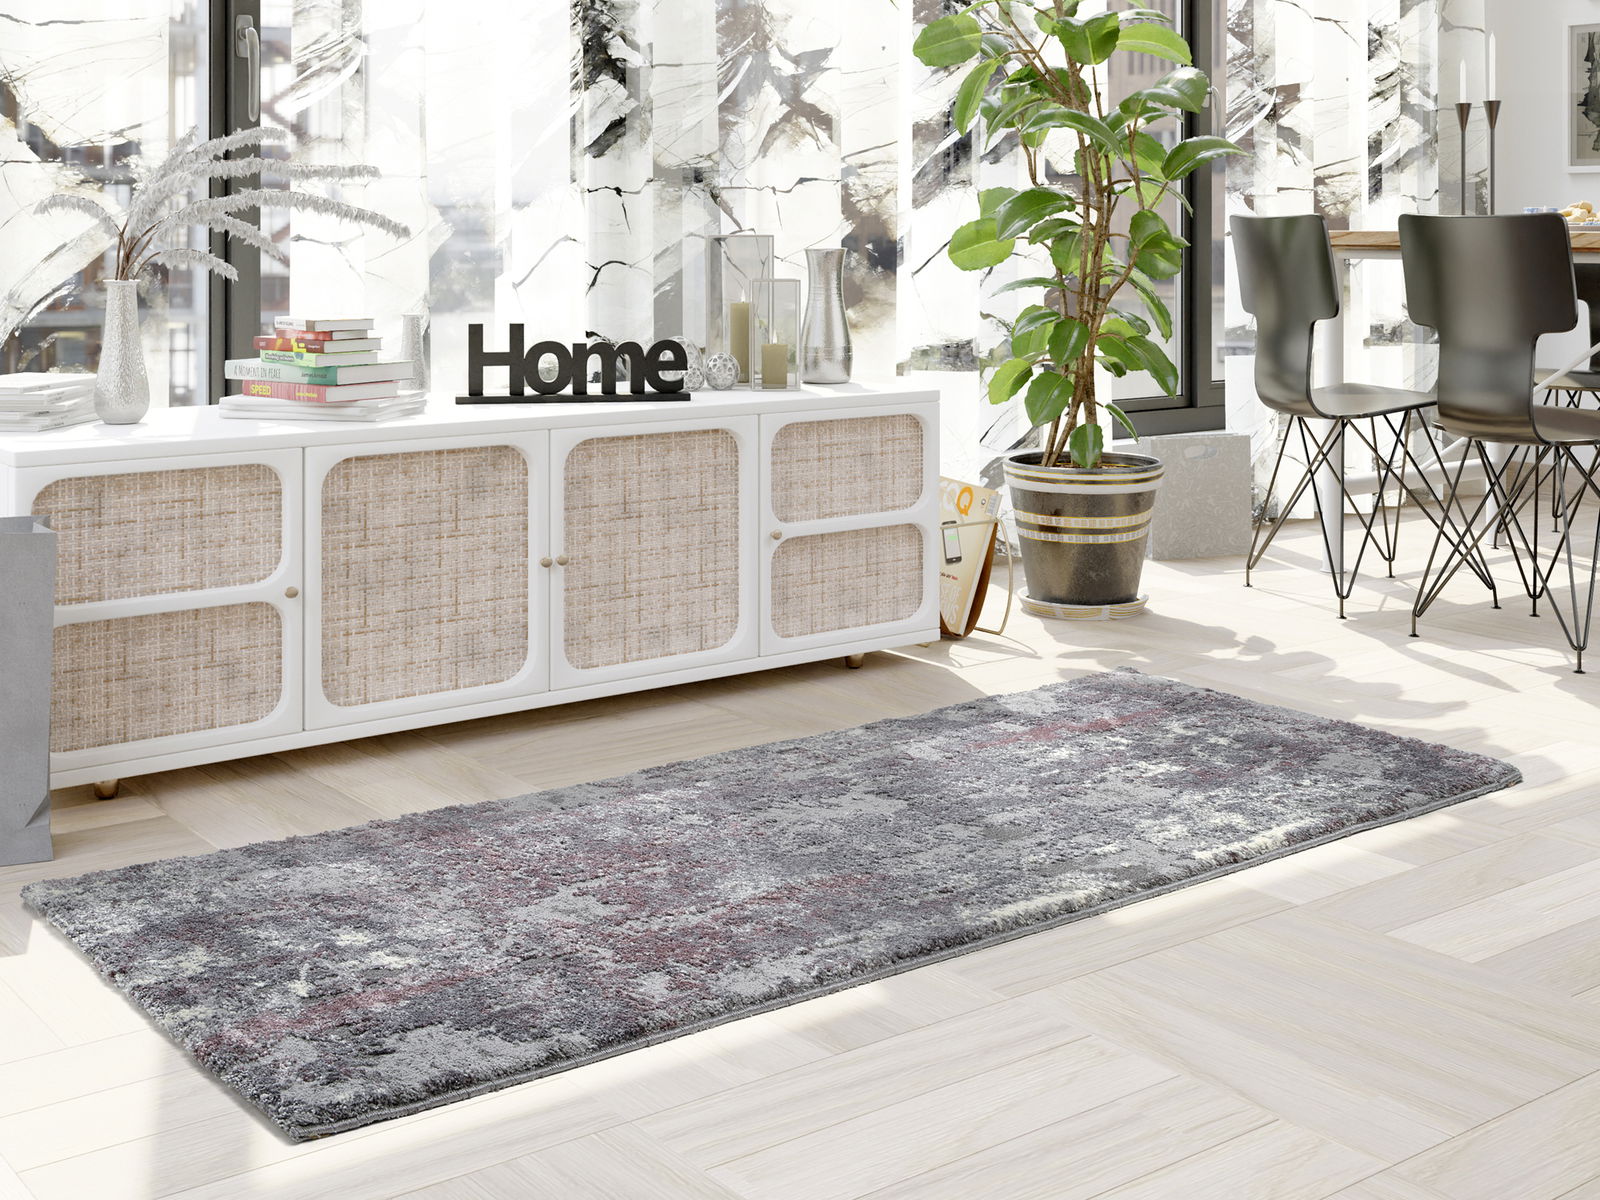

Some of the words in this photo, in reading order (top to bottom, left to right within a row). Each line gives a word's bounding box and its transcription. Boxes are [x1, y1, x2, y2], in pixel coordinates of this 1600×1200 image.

[468, 323, 688, 396] Home
[233, 365, 238, 377] A
[238, 365, 259, 378] MOMENT
[260, 367, 267, 378] IN
[267, 367, 281, 379] PEACE
[250, 384, 272, 395] SPEED
